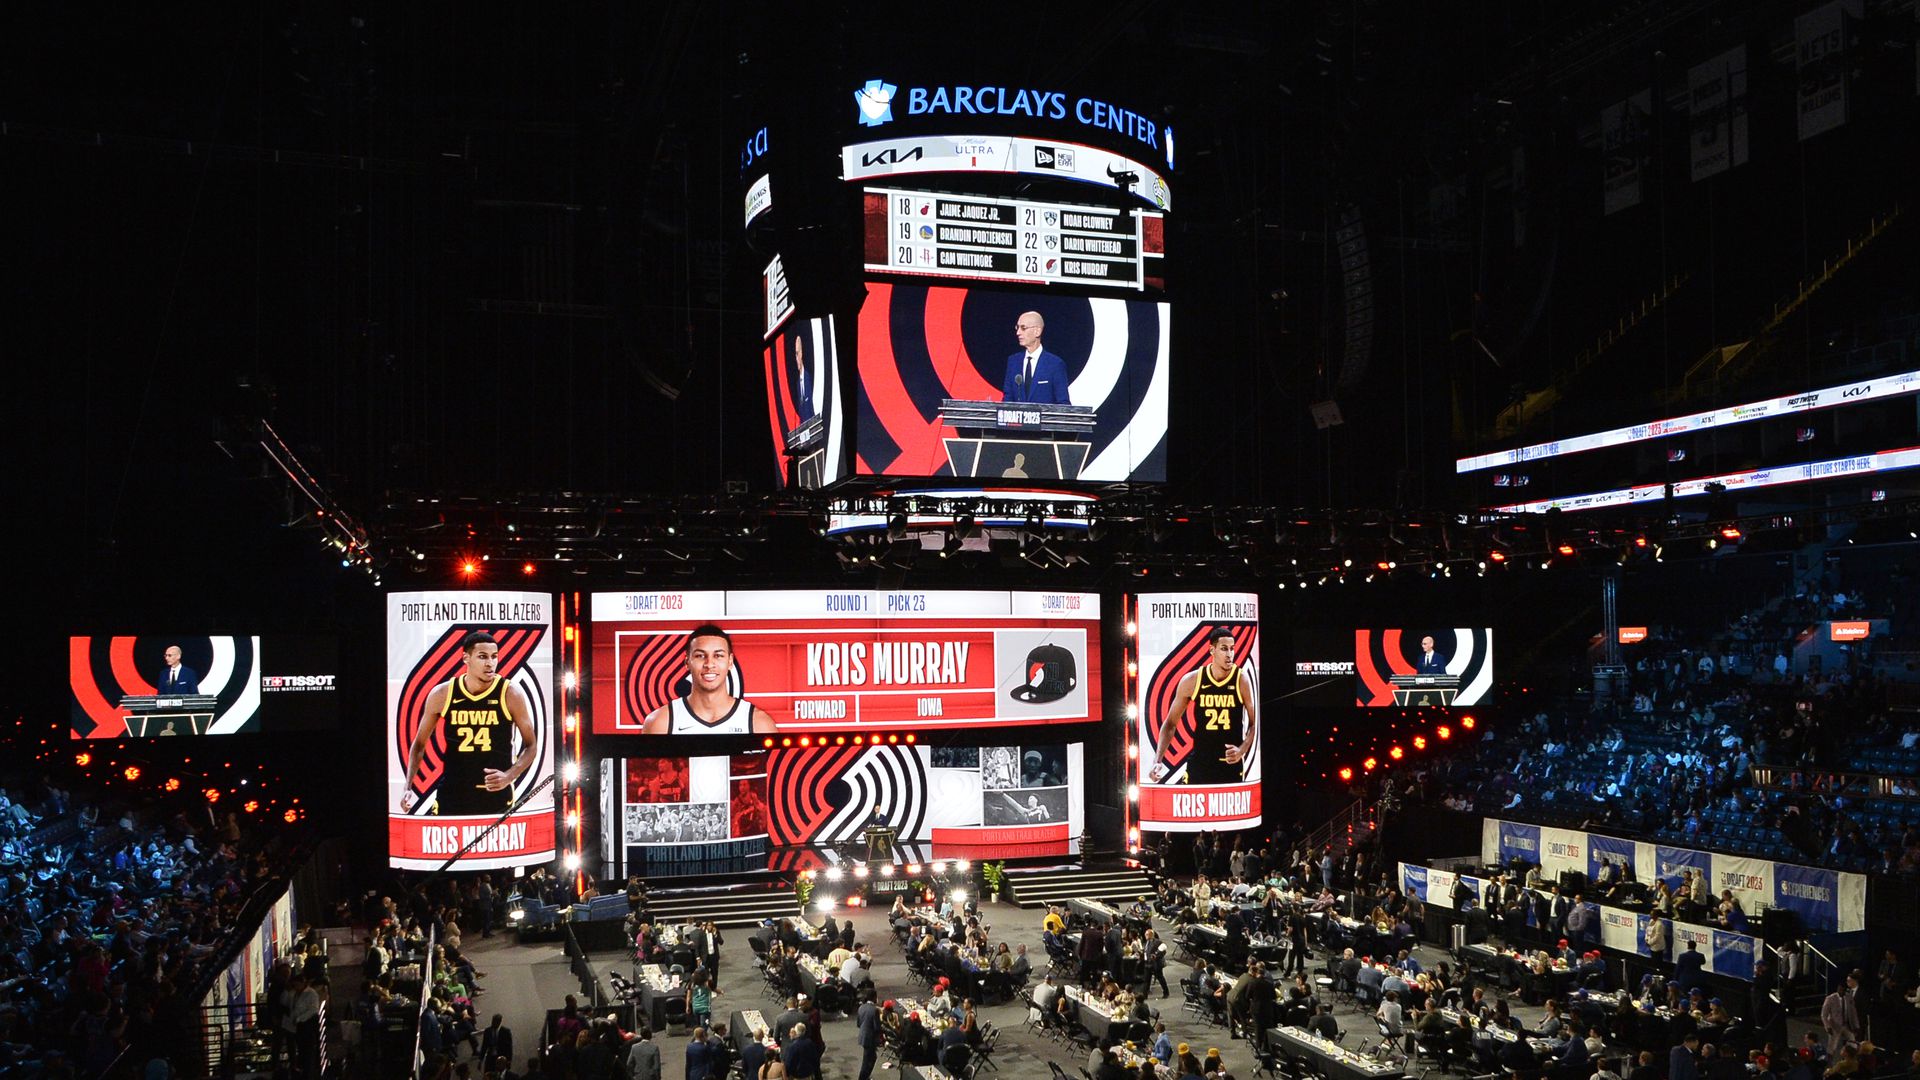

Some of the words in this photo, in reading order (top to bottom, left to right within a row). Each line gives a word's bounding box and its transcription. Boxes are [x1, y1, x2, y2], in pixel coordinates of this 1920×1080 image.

[908, 87, 1066, 119] BARCLAYS
[1075, 98, 1158, 149] CENTER
[862, 146, 923, 167] KIA
[955, 146, 994, 154] ULTRA
[900, 198, 910, 215] 18
[940, 203, 961, 218] JAIME
[962, 205, 988, 220] JAQUEZ
[1025, 209, 1036, 226] 21
[1063, 213, 1082, 228] NOAH
[1083, 215, 1113, 230] CLOWNEY
[900, 222, 911, 239] 19
[940, 227, 971, 242] BRANDIN
[1025, 232, 1038, 249] 22
[1063, 237, 1085, 252] DARIQ
[1085, 239, 1122, 254] WHITEHEAD
[899, 246, 912, 264] 20
[940, 251, 956, 266] CAM
[956, 253, 993, 268] WHITMORE
[1025, 256, 1038, 273] 23
[1063, 261, 1081, 275] KRIS
[1081, 262, 1108, 277] MURRAY
[1843, 385, 1871, 397] KIA
[1003, 410, 1024, 424] DRAFT
[1024, 411, 1041, 425] 2023
[1812, 462, 1833, 476] FUTURE
[1834, 459, 1856, 473] STARTS
[1856, 457, 1871, 469] HERE
[633, 595, 658, 610] DRAFT
[660, 594, 683, 610] 2023
[826, 595, 861, 612] ROUND
[863, 595, 868, 611] 1
[888, 594, 911, 612] PICK
[912, 594, 926, 612] 23
[1047, 595, 1065, 609] DRAFT
[1065, 595, 1081, 610] 2023
[1152, 602, 1206, 619] PORTLAND
[1208, 602, 1234, 619] TRAIL
[401, 603, 457, 622] PORTLAND
[461, 602, 496, 621] TRAIL
[499, 602, 541, 621] BLAZERS
[807, 642, 867, 686] KRIS
[872, 641, 970, 685] MURRAY
[1311, 662, 1355, 671] TISSOT
[282, 675, 336, 687] TISSOT
[917, 698, 943, 717] IOWA
[1199, 694, 1236, 708] IOWA
[450, 710, 499, 725] IOWA
[794, 700, 847, 720] FORWARD
[1205, 709, 1231, 730] 24
[457, 727, 492, 752] 24
[1172, 793, 1205, 818] KRIS
[1208, 790, 1252, 817] MURRAY
[422, 825, 459, 854] KRIS
[461, 822, 527, 853] MURRAY
[982, 831, 1016, 841] PORTLAND
[646, 845, 702, 862] PORTLAND
[705, 843, 732, 860] TRAIL
[732, 839, 766, 858] BLAZERS
[877, 881, 893, 891] DRAFT
[1726, 872, 1746, 888] DRAFT
[1746, 875, 1763, 891] 2023
